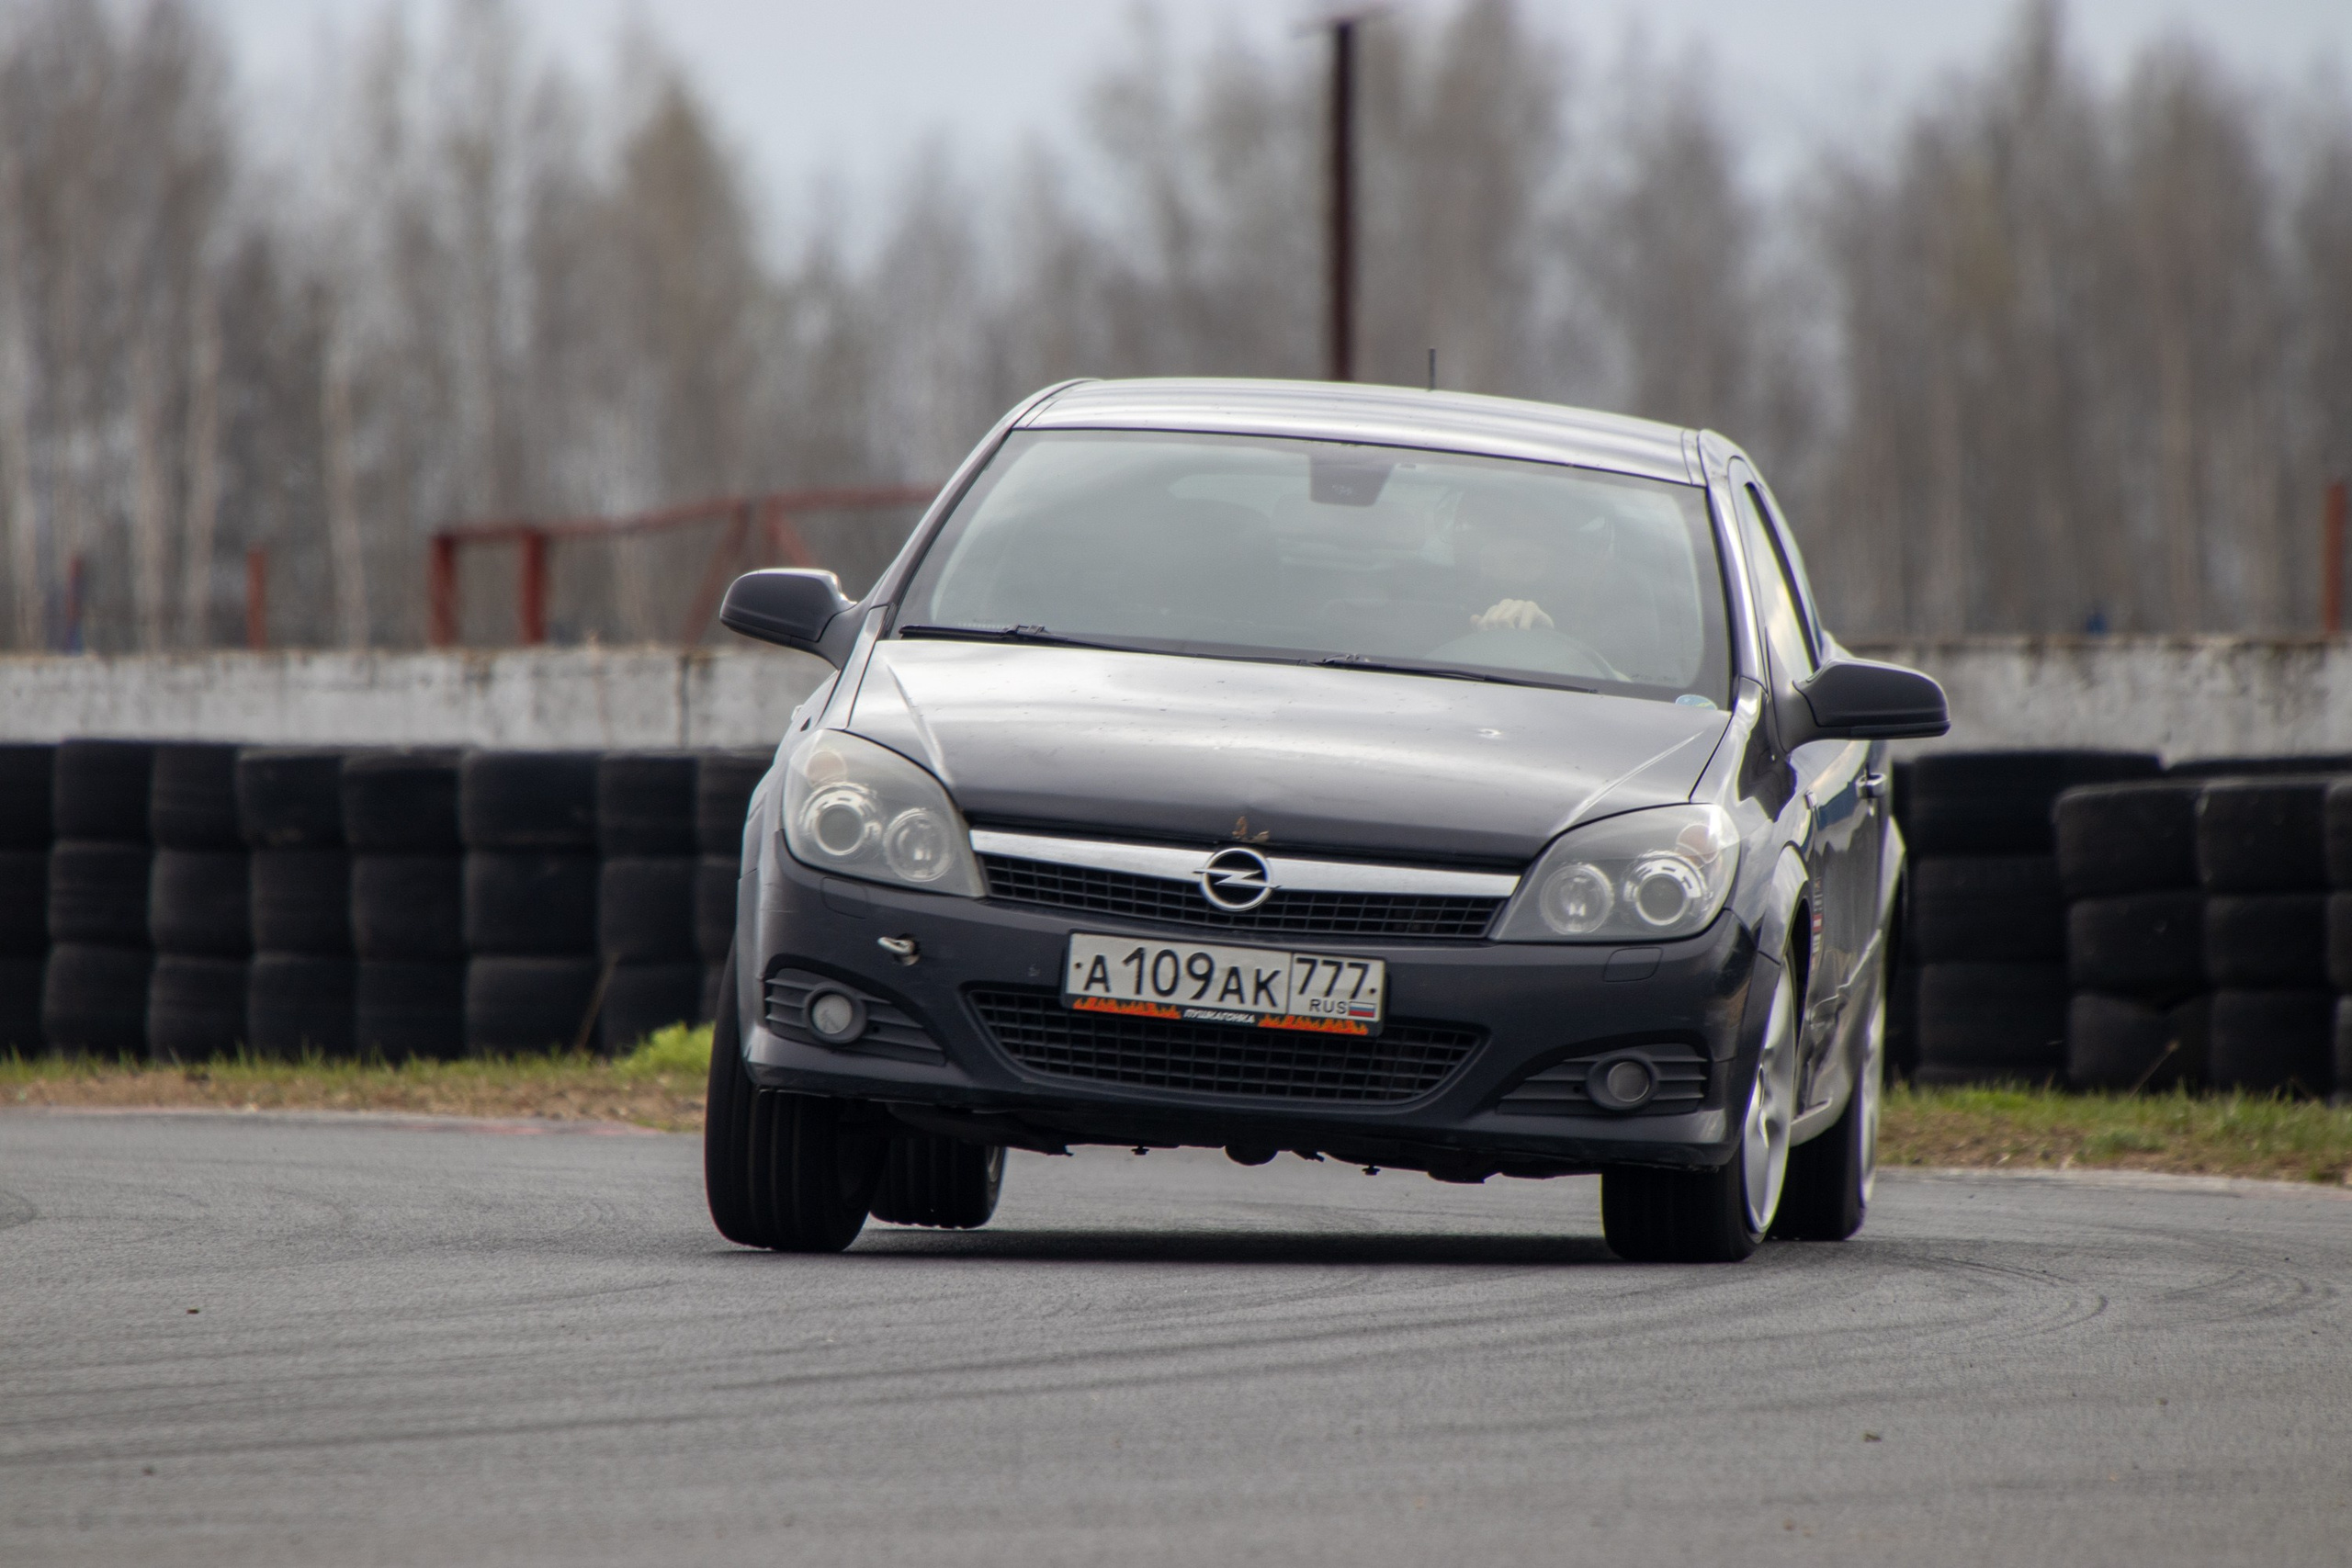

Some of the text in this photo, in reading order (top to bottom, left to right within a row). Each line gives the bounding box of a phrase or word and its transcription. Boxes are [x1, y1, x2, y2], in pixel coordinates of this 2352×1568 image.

[1083, 946, 1371, 1009] А109АК 777
[1309, 998, 1348, 1015] RUS
